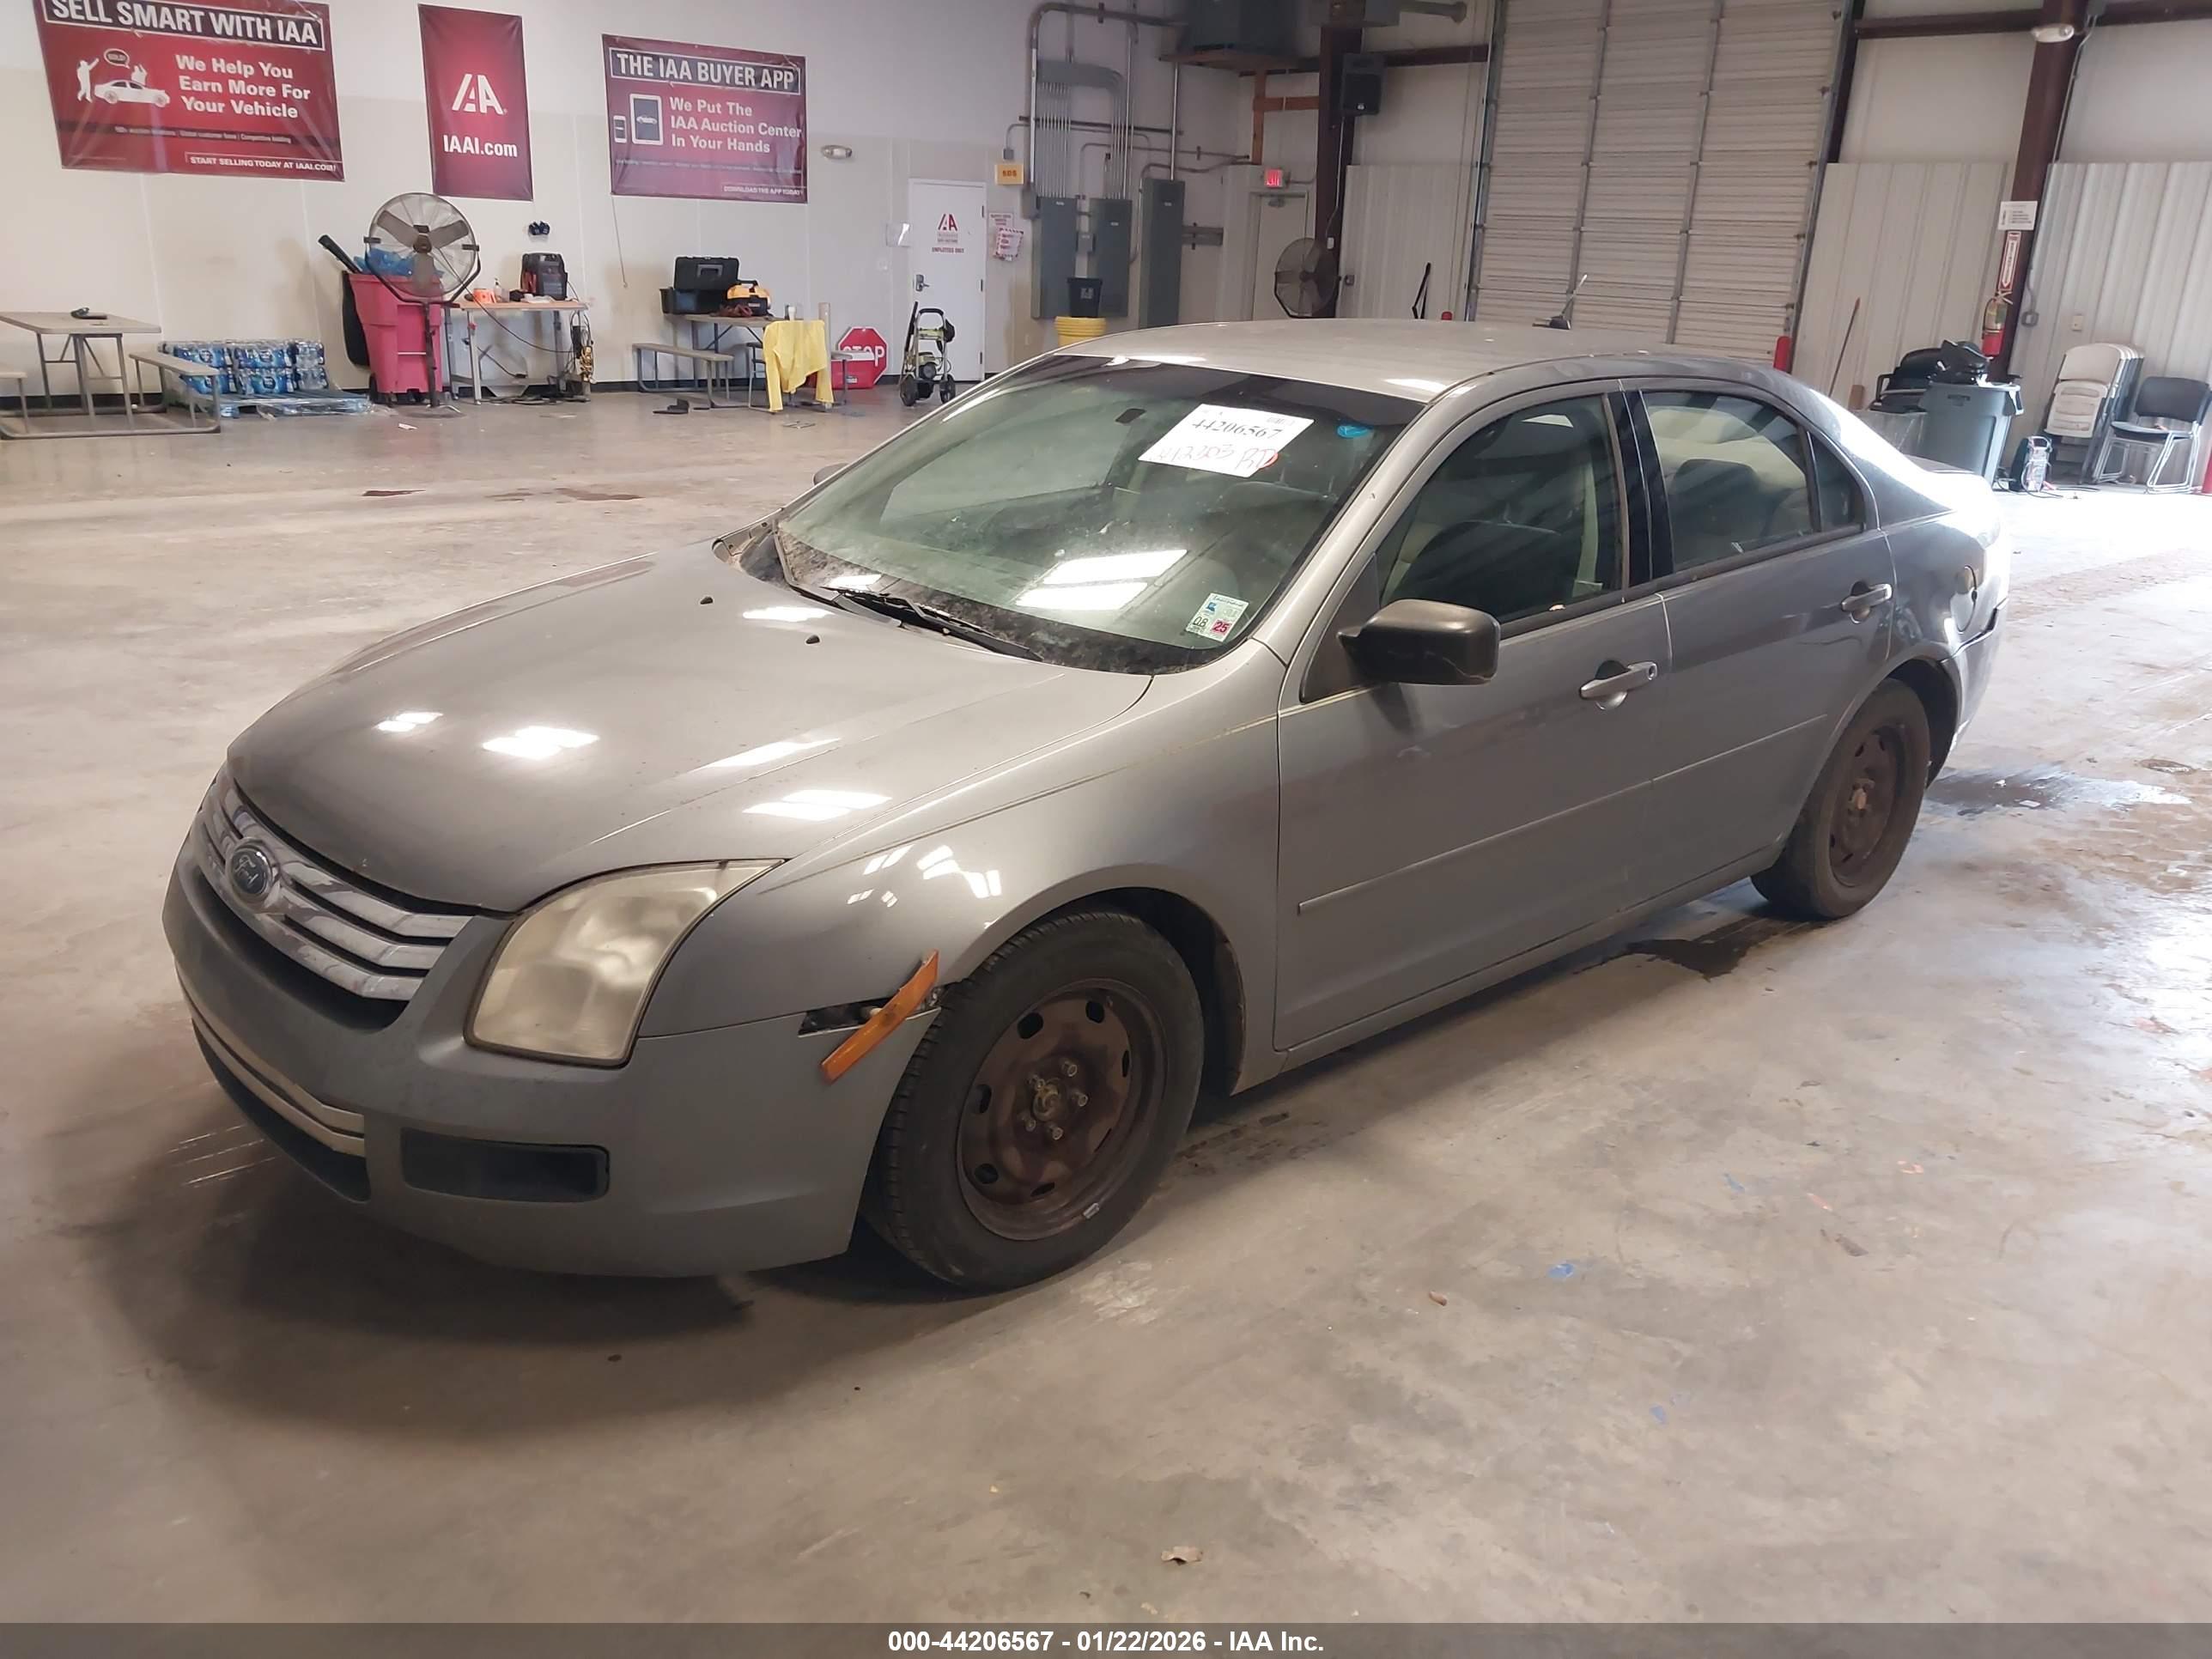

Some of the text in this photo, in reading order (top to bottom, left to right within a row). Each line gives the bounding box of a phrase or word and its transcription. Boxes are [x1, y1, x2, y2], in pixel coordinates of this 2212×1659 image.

[52, 0, 318, 45] SELL SMART WITH IAA
[175, 54, 294, 79] We Help You
[617, 53, 794, 90] THE IAA BUYER APP
[179, 76, 311, 100] Earn More For
[452, 73, 504, 115] IAA
[180, 95, 299, 118] Your Vehicle
[669, 96, 753, 116] We Put The
[671, 115, 802, 138] IAA Auction Center
[443, 134, 518, 158] IAAI.com
[672, 134, 770, 153] In Your Hands
[190, 156, 217, 165] START
[219, 158, 254, 167] SELLING
[254, 160, 282, 168] TODAY
[1191, 419, 1284, 440] 44206567
[1213, 621, 1229, 633] 25
